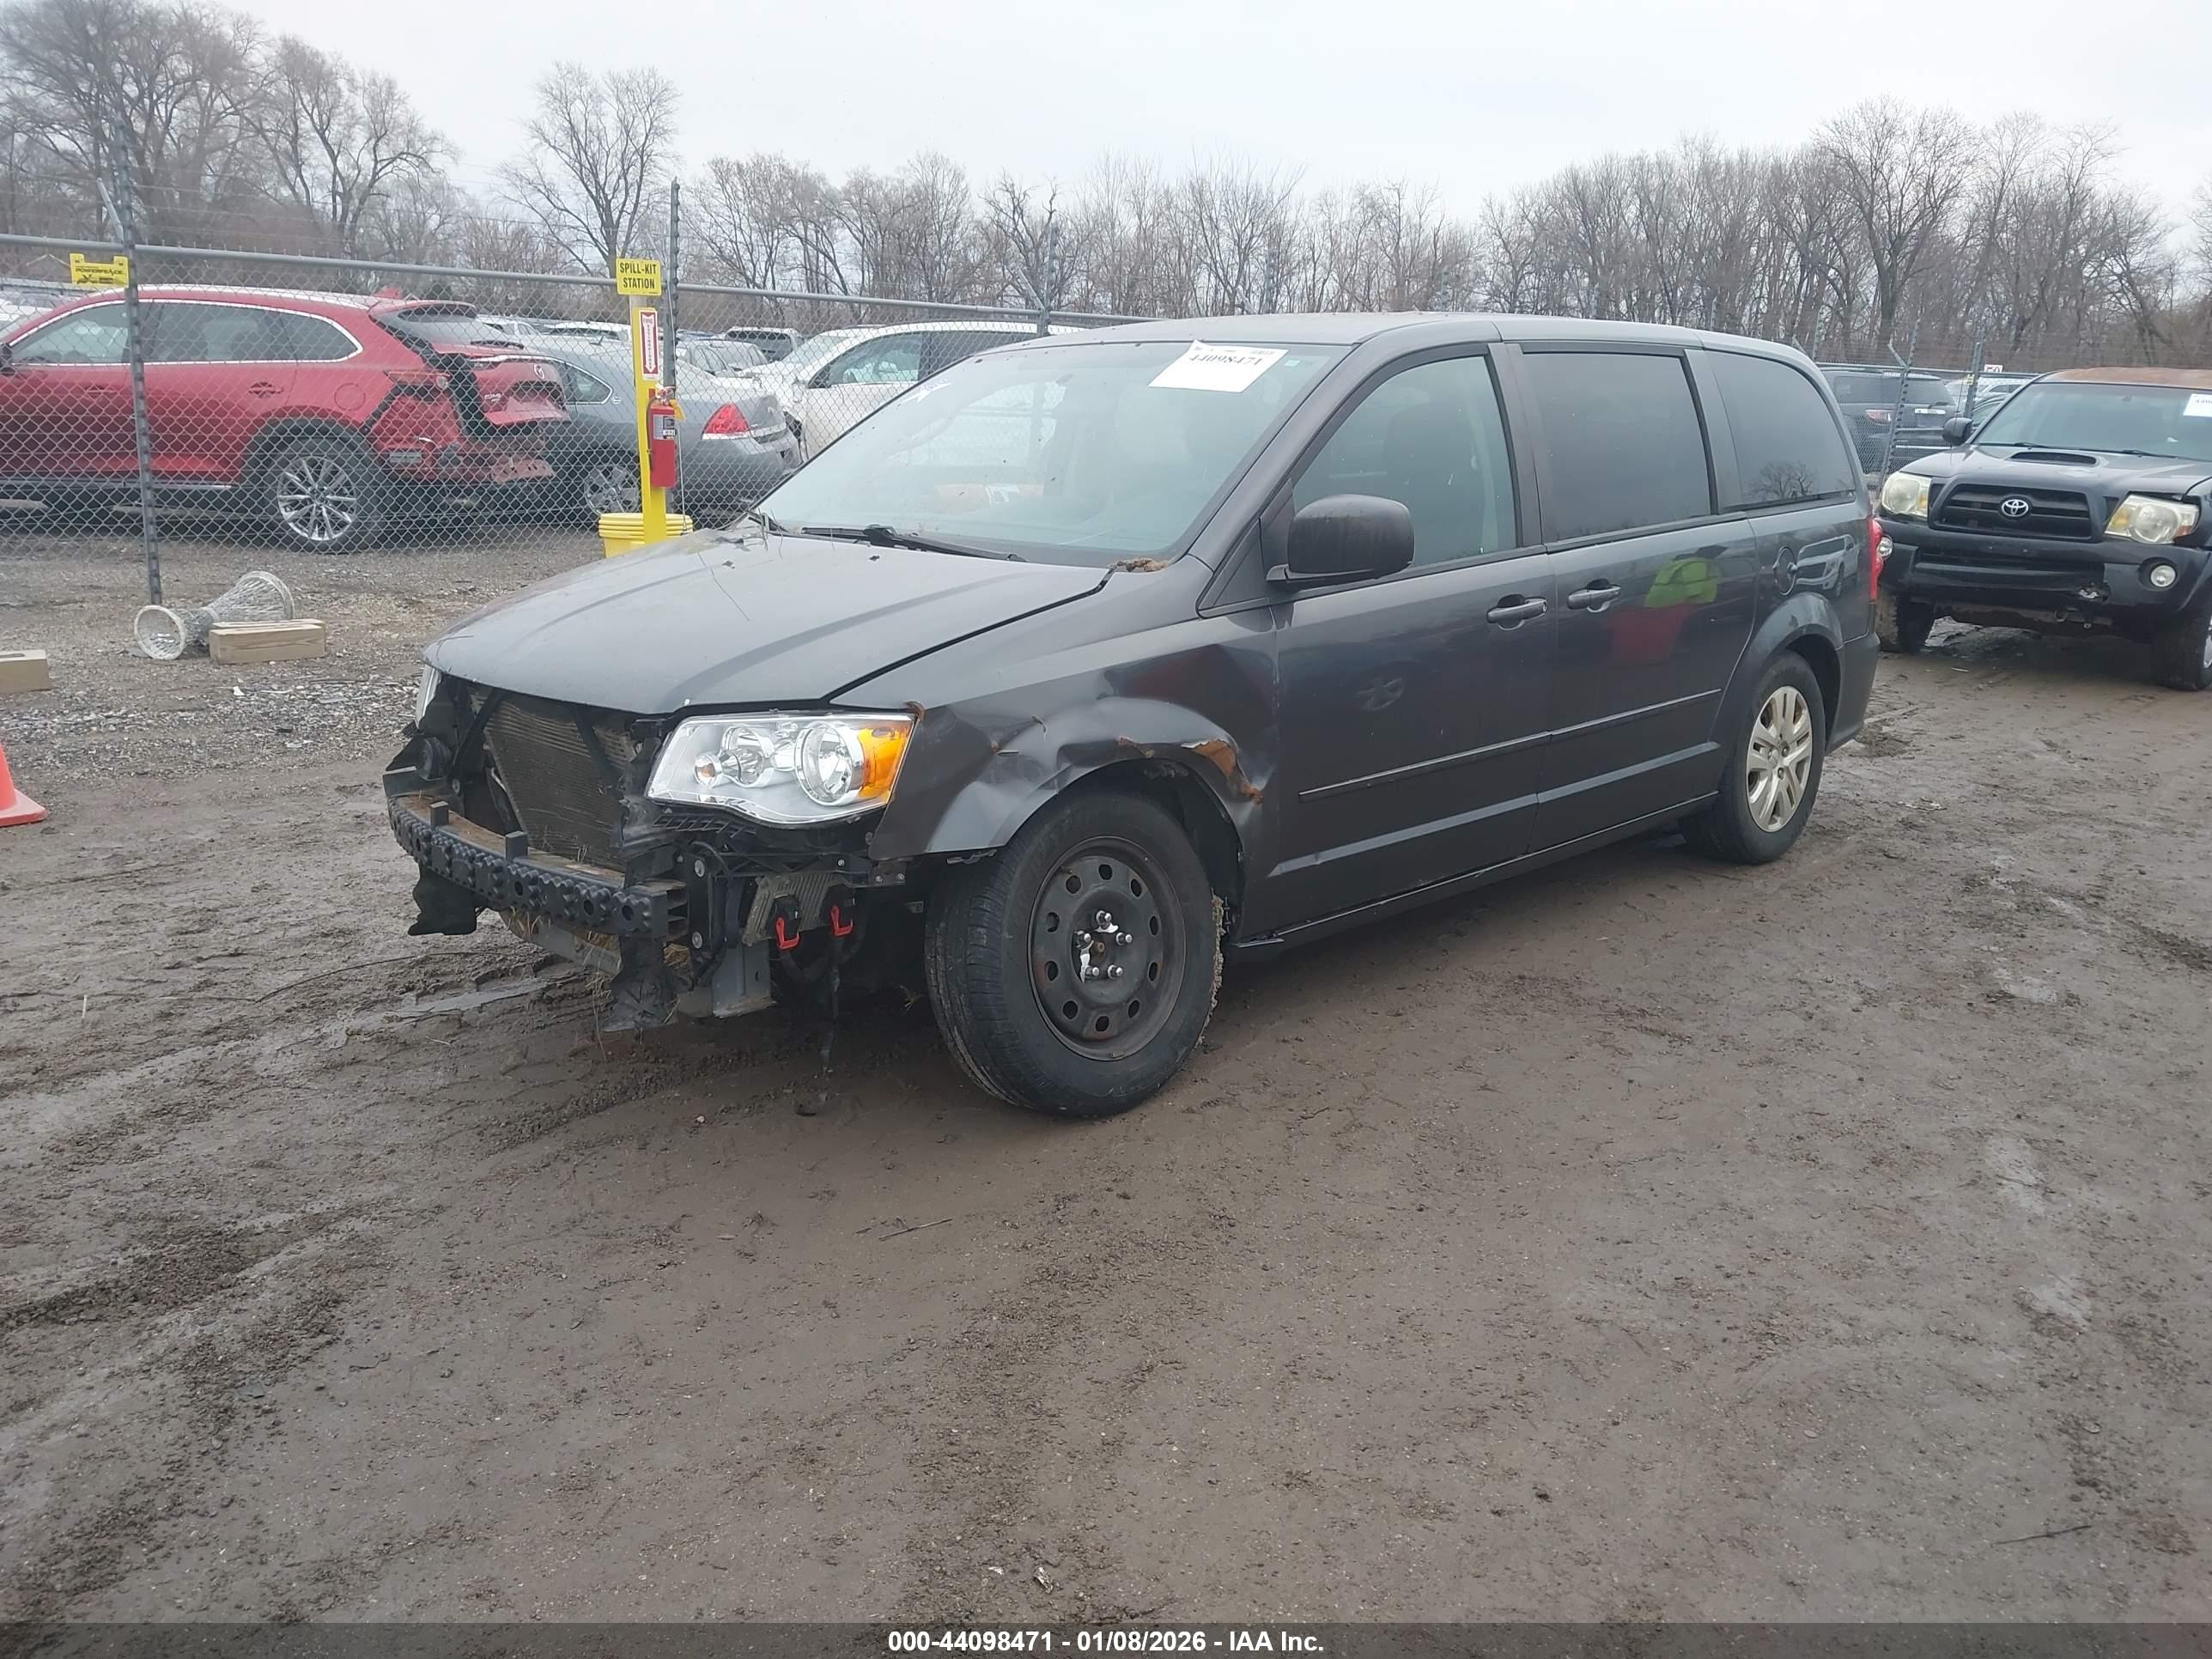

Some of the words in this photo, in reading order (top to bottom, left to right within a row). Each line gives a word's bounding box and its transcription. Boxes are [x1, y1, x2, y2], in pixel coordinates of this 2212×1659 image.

[620, 263, 657, 274] SPILL-KIT
[623, 277, 655, 289] STATION
[1189, 355, 1263, 365] 44098471
